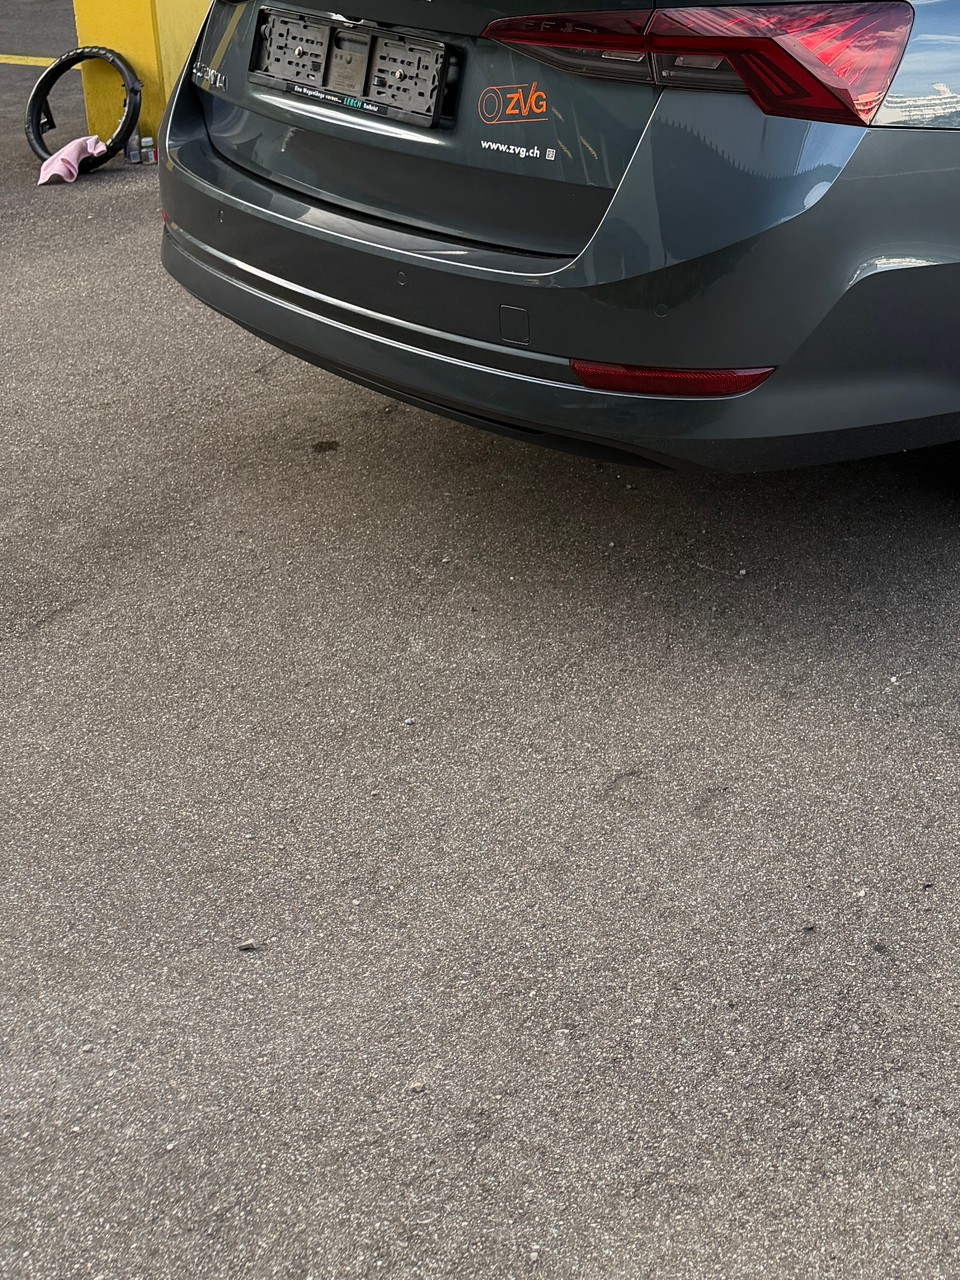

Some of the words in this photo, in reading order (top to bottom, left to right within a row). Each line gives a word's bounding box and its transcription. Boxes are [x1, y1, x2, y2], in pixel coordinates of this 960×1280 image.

[343, 97, 362, 109] LERCH
[505, 81, 547, 116] ZVG
[480, 140, 540, 158] www.zvg.ch
